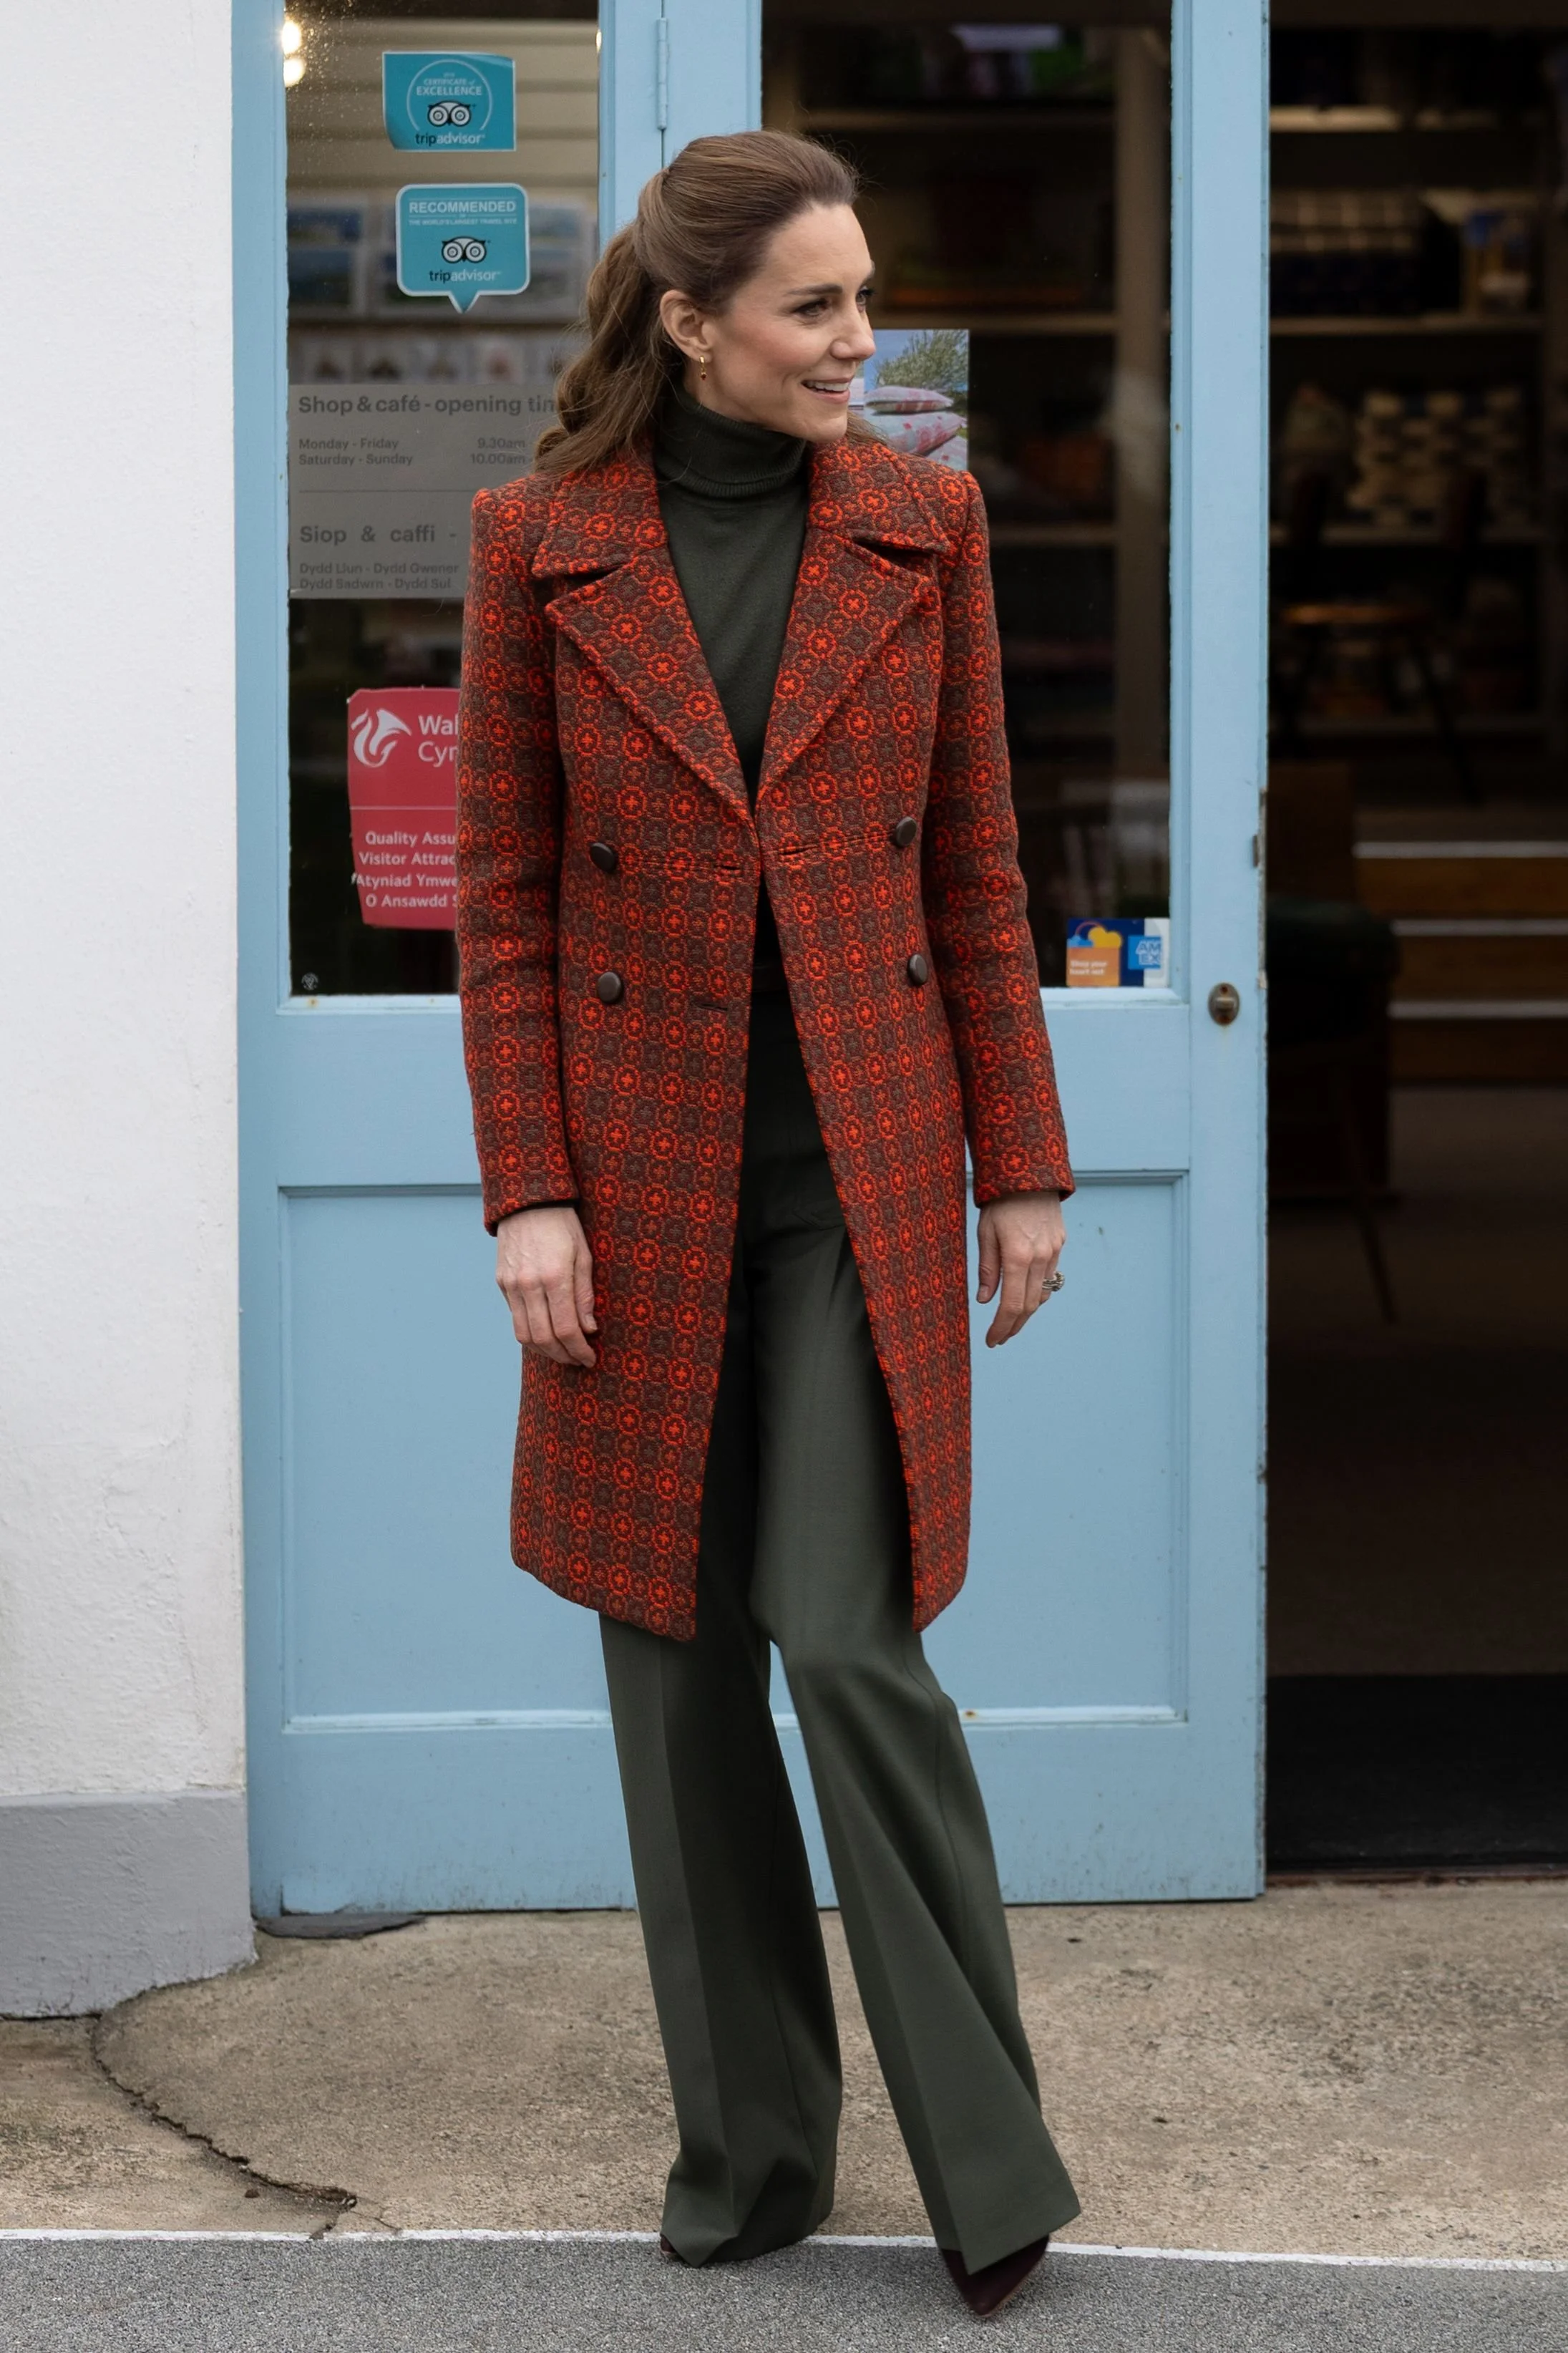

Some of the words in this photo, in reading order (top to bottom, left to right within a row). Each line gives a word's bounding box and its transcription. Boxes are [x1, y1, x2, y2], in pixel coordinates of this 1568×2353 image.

[417, 86, 482, 95] EXCELLENCE
[415, 132, 482, 147] tripadvisor
[409, 200, 516, 213] RECOMMENDED
[429, 268, 497, 283] tripadvisor
[298, 395, 353, 416] Shop
[357, 395, 372, 412] &
[376, 394, 421, 412] café
[435, 395, 522, 416] opening
[528, 395, 555, 412] ti
[299, 438, 349, 451] Monday
[360, 437, 399, 450] Friday
[477, 437, 525, 449] 9.30am
[298, 454, 355, 467] Saturday
[366, 453, 413, 466] Sunday
[471, 452, 525, 465] 10.00am
[300, 525, 347, 545] Siop
[361, 525, 376, 543] &
[390, 525, 435, 543] caffi
[299, 563, 332, 575] Dydd
[374, 563, 406, 575] Dydd
[299, 578, 332, 591] Dydd
[394, 578, 427, 591] Dydd
[431, 577, 452, 589] Sul
[418, 713, 458, 737] Wal
[418, 740, 458, 768] Cy
[365, 830, 417, 848] Quality
[422, 831, 457, 845] Assu
[359, 851, 406, 865] Visitor
[411, 852, 456, 865] Attrac
[356, 873, 412, 891] Atyniad
[416, 873, 458, 888] Ymwe
[365, 893, 376, 908] O
[381, 893, 447, 908] Ansawdd
